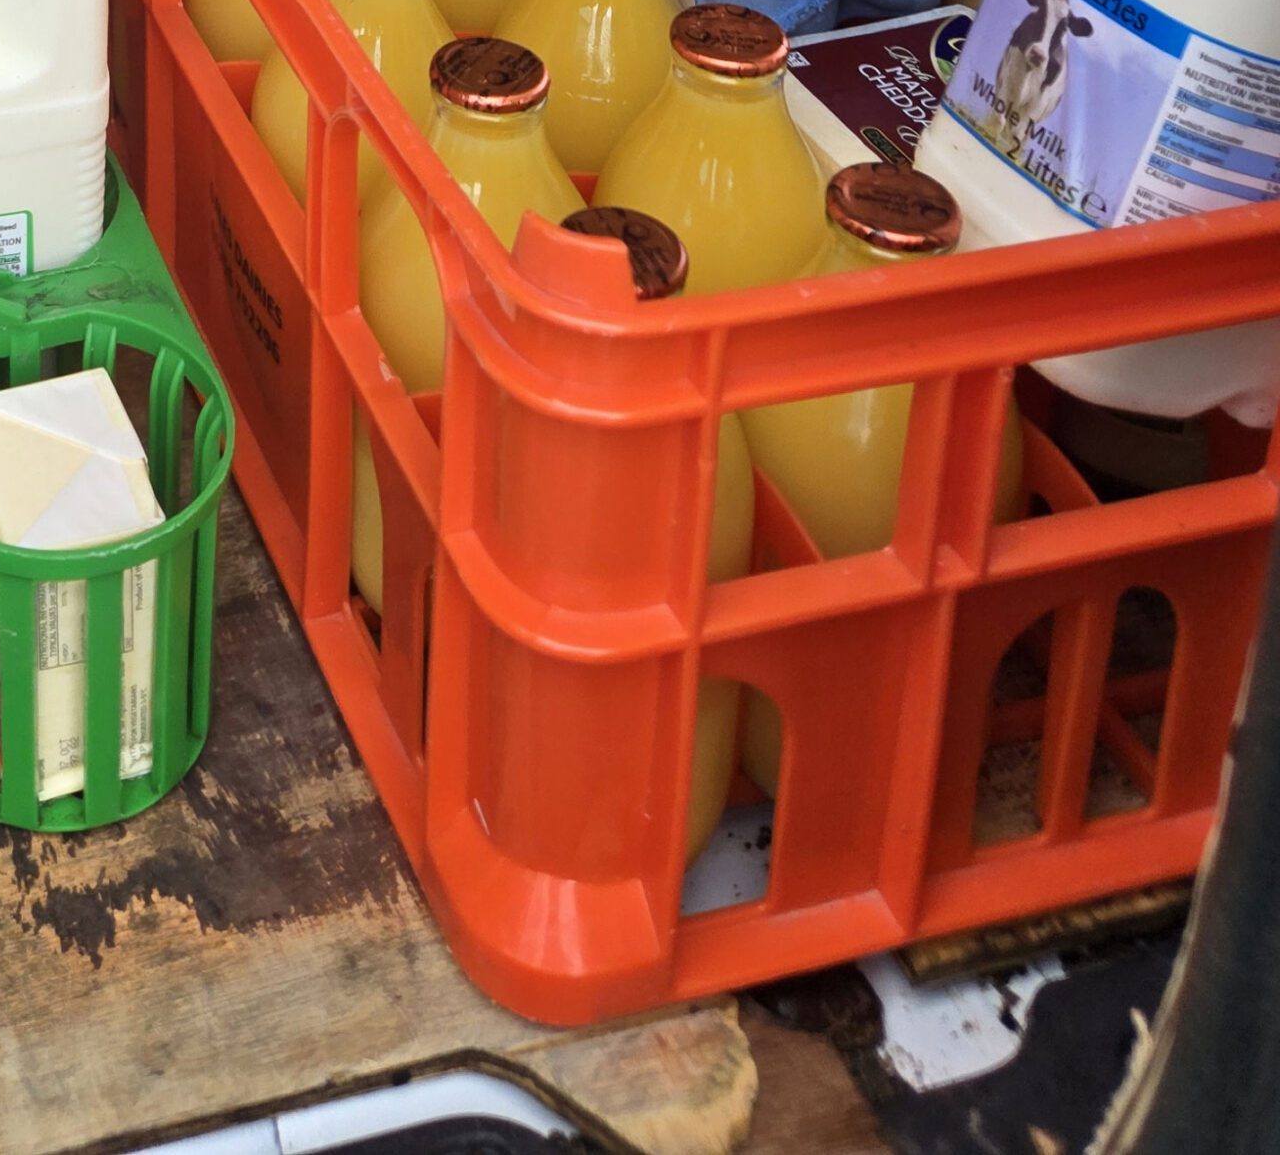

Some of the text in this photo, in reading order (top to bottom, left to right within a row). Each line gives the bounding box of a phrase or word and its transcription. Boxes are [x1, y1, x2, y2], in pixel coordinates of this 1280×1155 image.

[972, 72, 1021, 129] Whole
[1025, 117, 1066, 163] Milk
[1172, 101, 1188, 113] FAT
[1005, 136, 1079, 205] 2 Litres
[135, 584, 145, 611] Product
